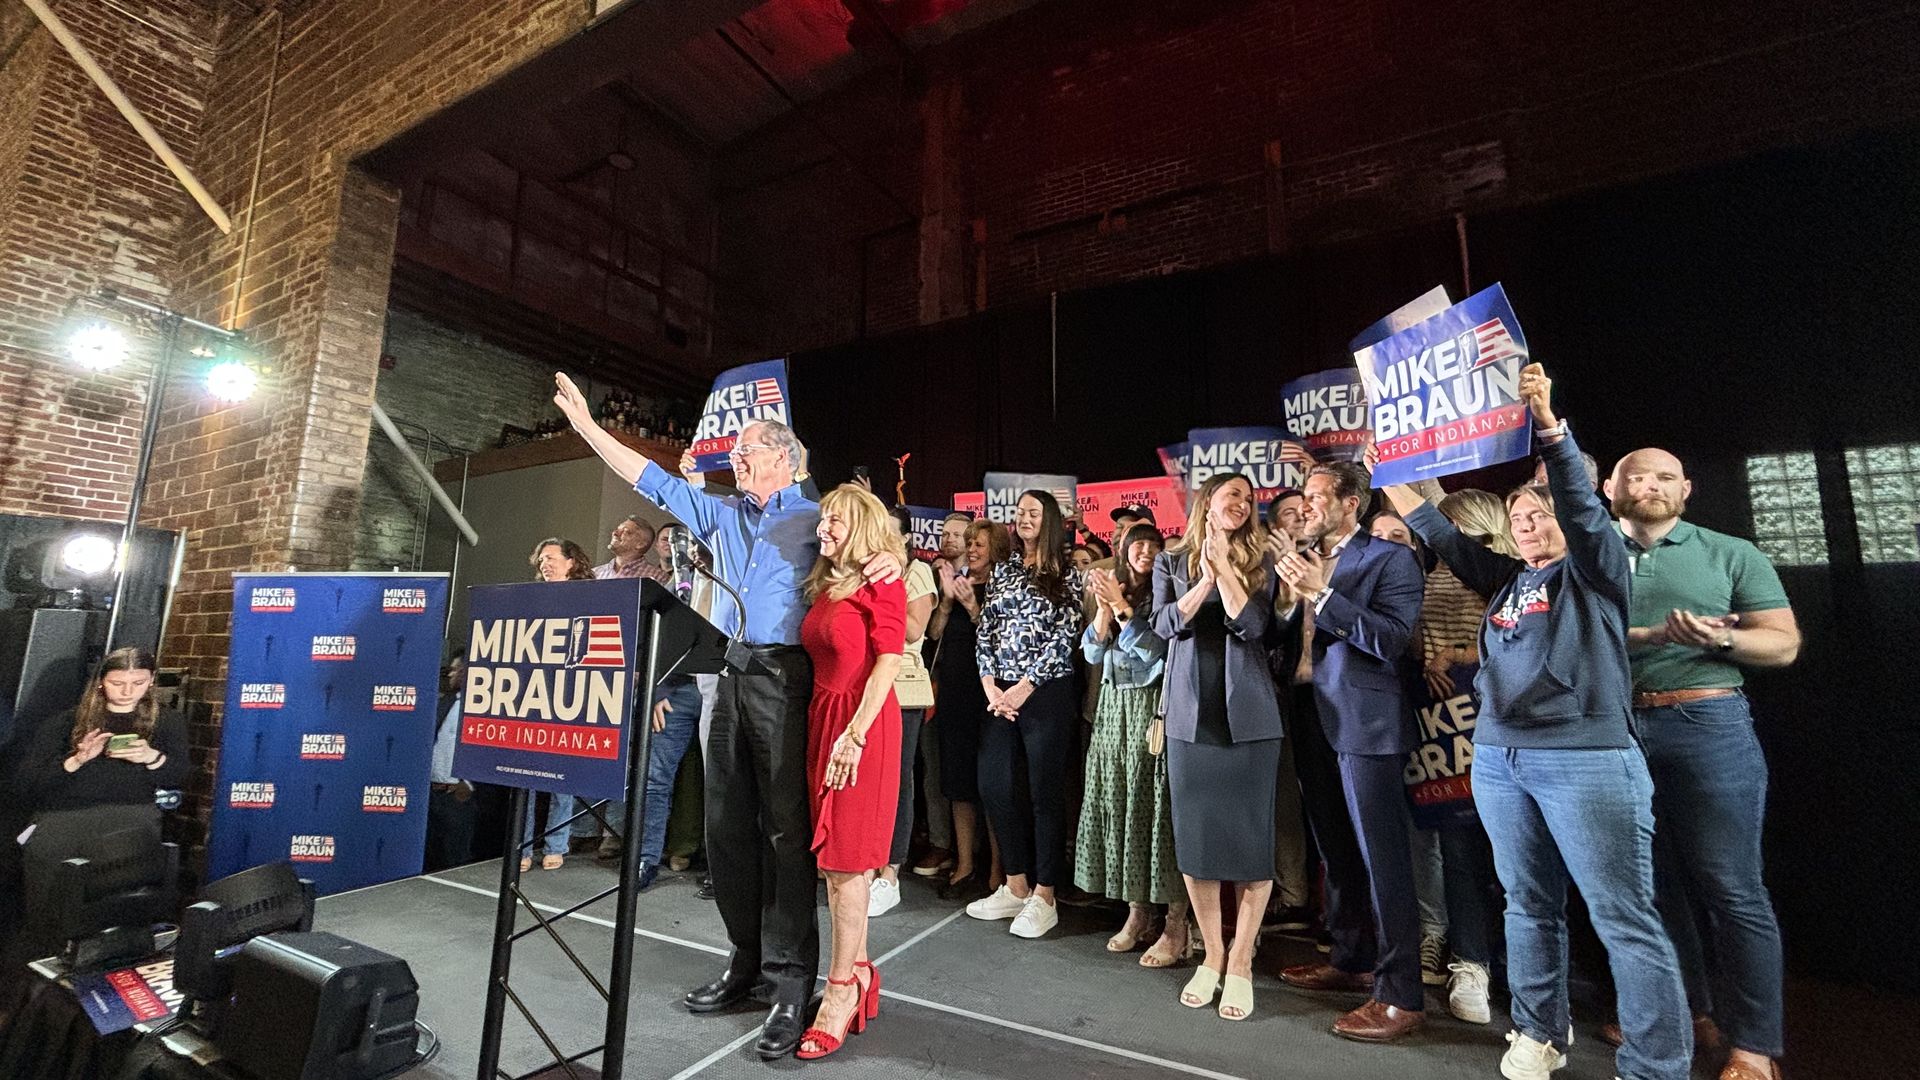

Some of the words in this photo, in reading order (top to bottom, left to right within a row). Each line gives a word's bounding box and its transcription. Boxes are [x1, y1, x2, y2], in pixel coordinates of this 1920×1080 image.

[1373, 340, 1461, 405] MIKE
[703, 383, 746, 416] IKE
[1284, 385, 1348, 418] MIKE
[1375, 357, 1521, 442] BRAUN
[1391, 440, 1419, 455] FOR
[1429, 414, 1506, 446] INDIANA
[697, 443, 718, 453] FOR
[1193, 441, 1267, 466] MIKE
[1121, 492, 1144, 500] MIKE
[252, 587, 281, 597] MIKE
[383, 588, 412, 597] MIKE
[251, 597, 295, 607] BRAUN
[383, 598, 426, 608] BRAUN
[313, 636, 341, 645] MIKE
[469, 618, 570, 664] MIKE
[312, 645, 356, 655] BRAUN
[242, 684, 270, 693] MIKE
[374, 686, 402, 695] MIKE
[240, 693, 285, 703] BRAUN
[373, 695, 416, 706] BRAUN
[464, 667, 625, 725] BRAUN
[302, 734, 331, 743] MIKE
[476, 723, 507, 742] FOR
[516, 727, 598, 751] INDIANA
[301, 743, 345, 754] BRAUN
[231, 782, 260, 792] MIKE
[363, 786, 392, 796] MIKE
[230, 792, 275, 802] BRAUN
[362, 795, 406, 807] BRAUN
[292, 835, 320, 845] MIKE
[290, 845, 334, 856] BRAUN
